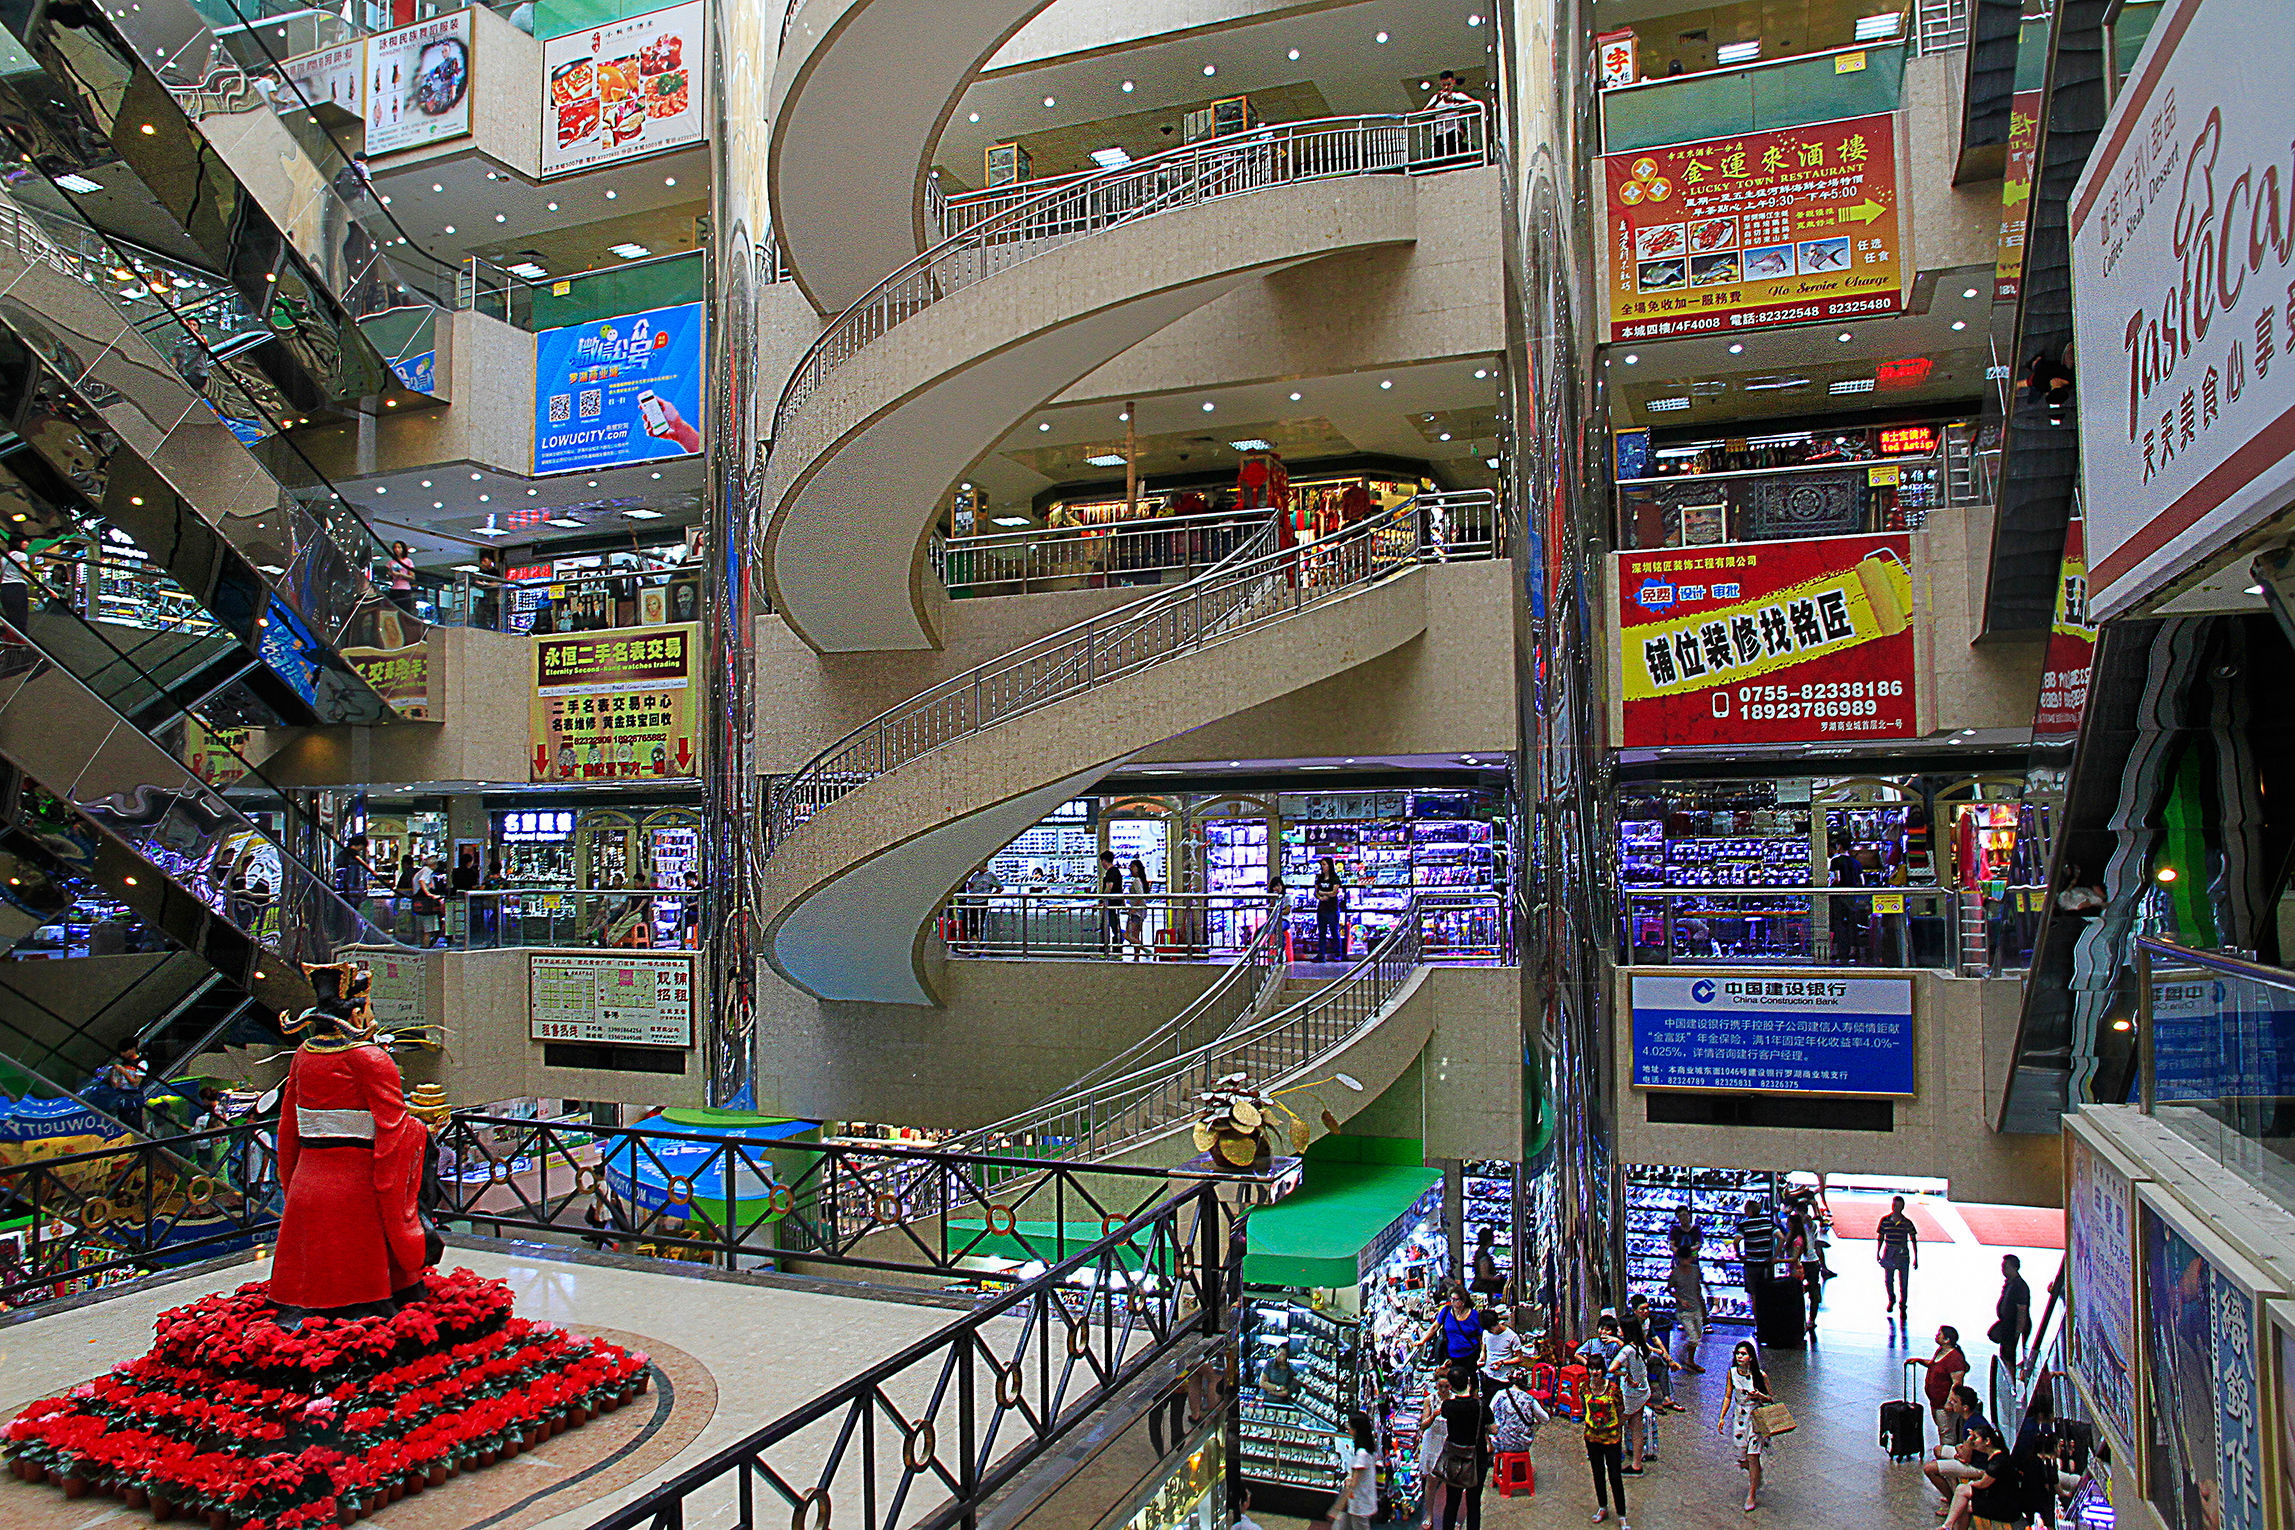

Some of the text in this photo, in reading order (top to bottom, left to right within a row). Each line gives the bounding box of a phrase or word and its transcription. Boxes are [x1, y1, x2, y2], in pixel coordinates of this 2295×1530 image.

[1681, 133, 1869, 185] 金運來酒樓
[1690, 162, 1864, 196] LUCKY TOWN RESTAURANT
[1769, 273, 1889, 297] No Service Charge
[1621, 290, 1742, 315] 全場免收加一服務費
[1622, 298, 1891, 338] 本城四樓/4F4008 電話:82322548 82325480
[541, 429, 628, 450] LOWUCITY.com
[1631, 555, 1757, 574] 深圳铭匠装饰工程有限公司
[1641, 583, 1741, 603] 免费 设计 审批
[1643, 590, 1856, 687] 铺位装修找铭匠
[545, 637, 682, 668] 永恒二手名表交易
[546, 668, 573, 676] Eternity
[622, 662, 652, 671] watches
[653, 660, 680, 669] trading
[1738, 680, 1903, 702] 0755-82338186
[552, 694, 672, 715] 二手名表交易中心
[1739, 700, 1877, 721] 18923786989
[552, 713, 672, 732] 名表维修 黄金珠宝回收
[1820, 719, 1903, 733] 罗湖商业城首层北一号
[1724, 981, 1847, 997] 中国建设银行
[1732, 996, 1839, 1006] China Construction Bank
